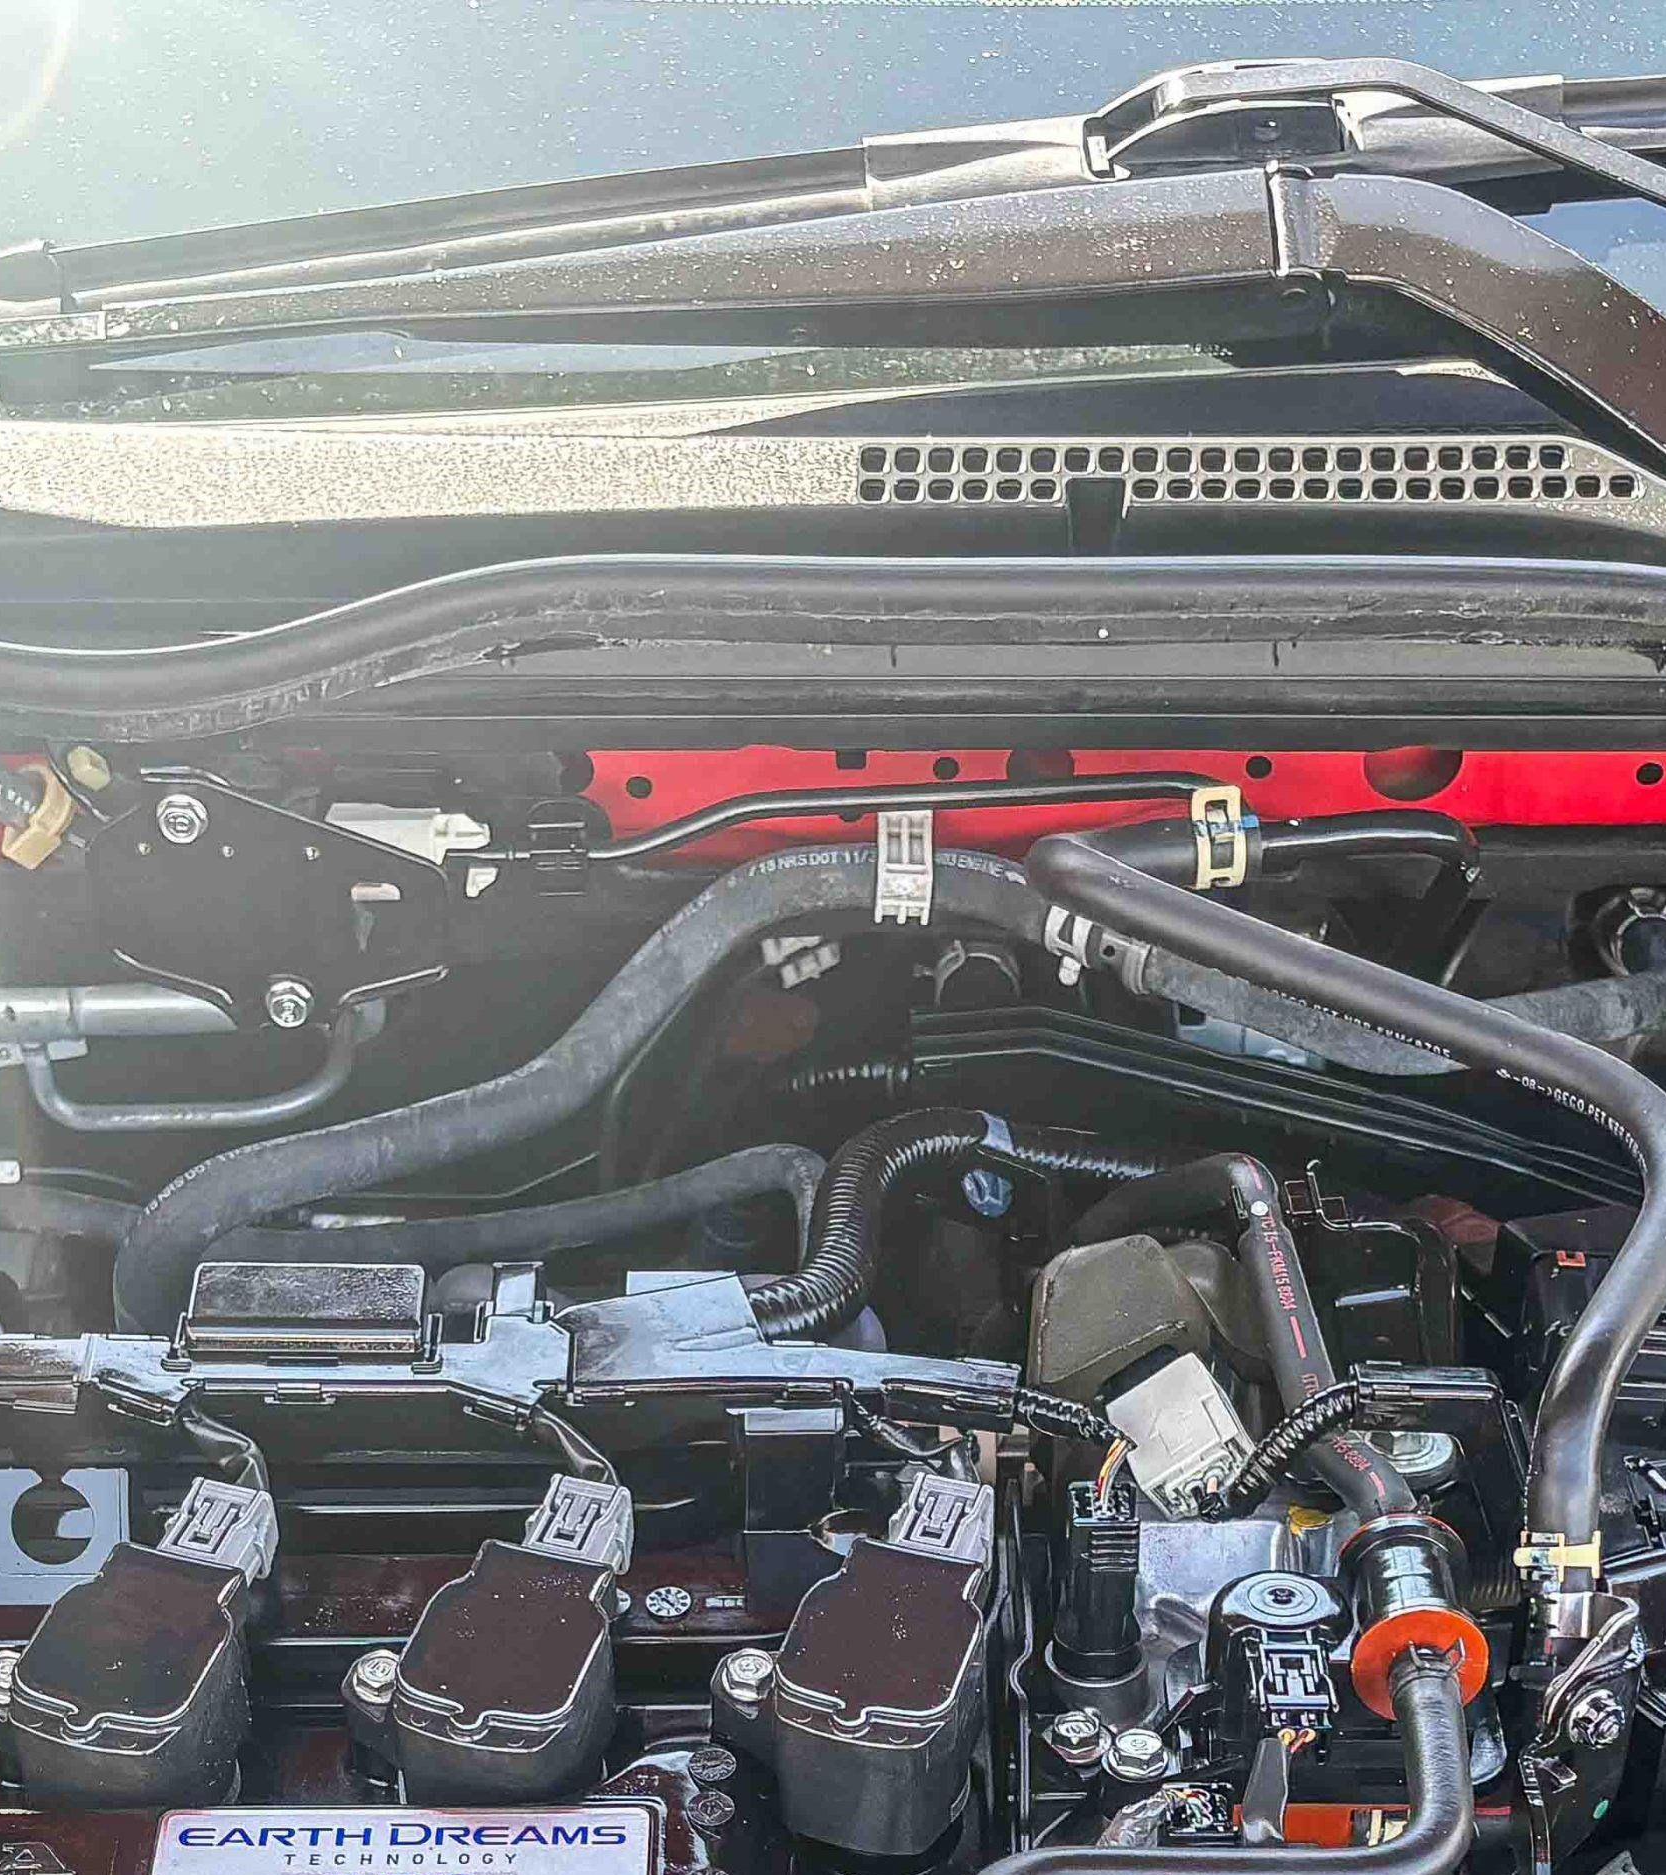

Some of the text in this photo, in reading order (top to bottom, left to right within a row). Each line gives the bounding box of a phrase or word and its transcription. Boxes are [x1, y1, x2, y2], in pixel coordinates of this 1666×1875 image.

[178, 1823, 627, 1848] EARTH DREAMS
[284, 1853, 519, 1867] TECHNOLOGY
